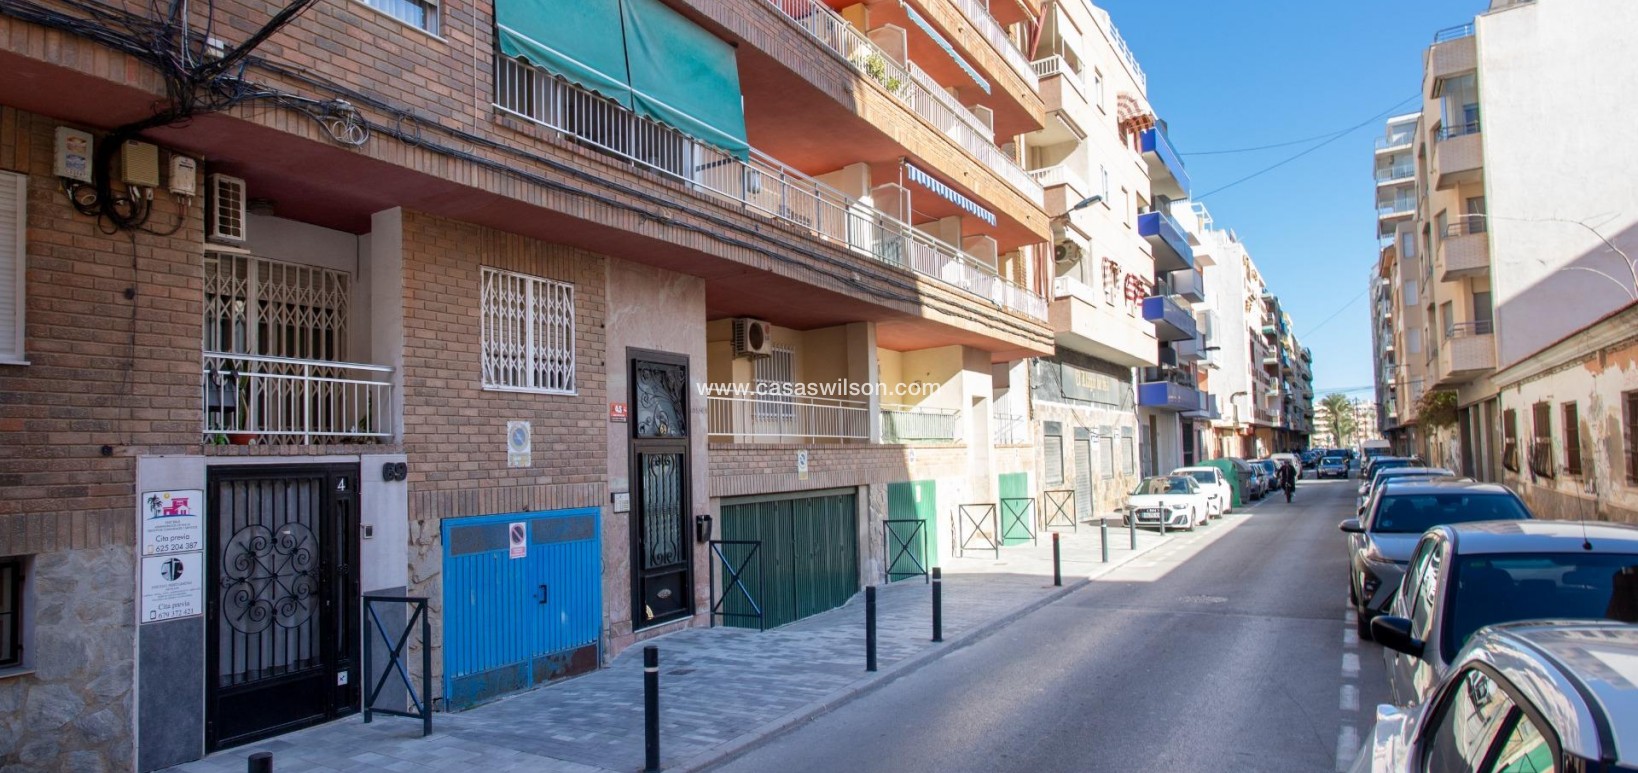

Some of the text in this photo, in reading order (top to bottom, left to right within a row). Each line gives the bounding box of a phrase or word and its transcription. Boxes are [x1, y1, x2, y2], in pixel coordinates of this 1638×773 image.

[383, 462, 408, 482] 69
[337, 477, 346, 492] 4
[155, 533, 190, 543] Cita previa
[155, 541, 198, 552] 625 204 387
[158, 603, 171, 611] Cita
